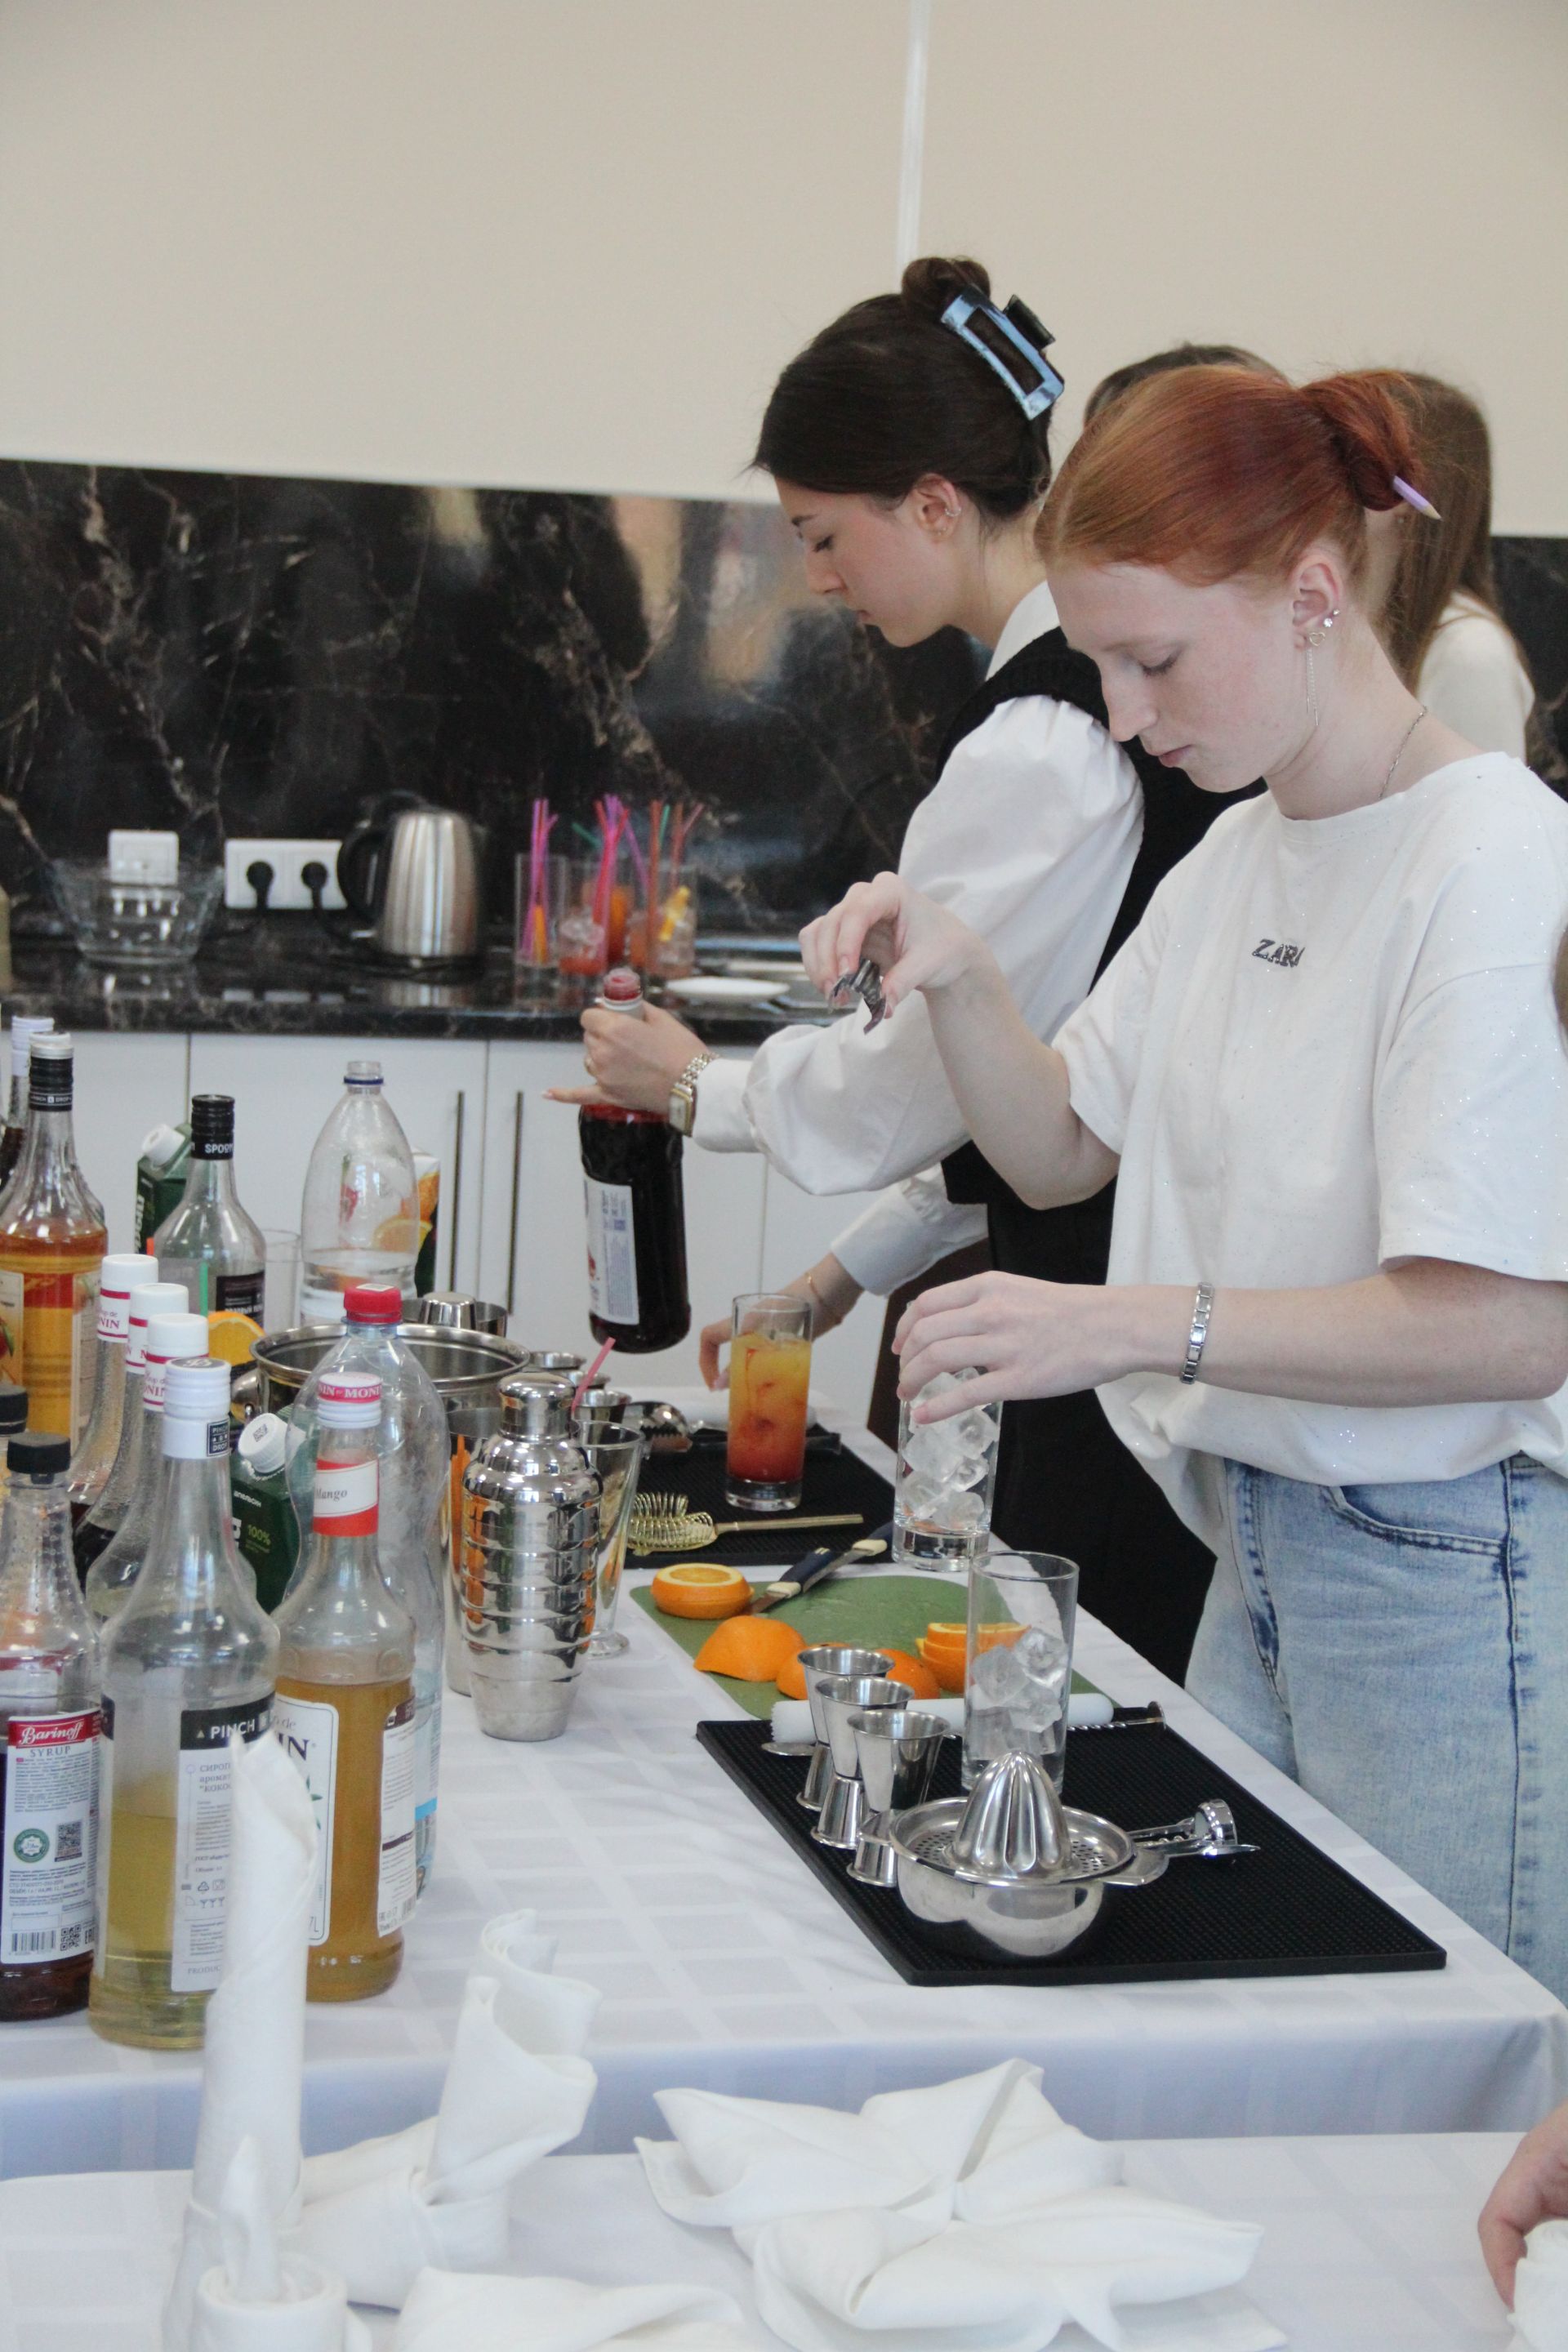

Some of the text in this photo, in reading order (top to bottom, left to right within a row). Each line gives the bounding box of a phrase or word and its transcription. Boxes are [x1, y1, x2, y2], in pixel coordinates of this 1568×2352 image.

[248, 1524, 271, 1545] 100%
[19, 1721, 85, 1745] Barinoff
[210, 1719, 256, 1740] PINCH
[29, 1745, 71, 1757] SYRUP
